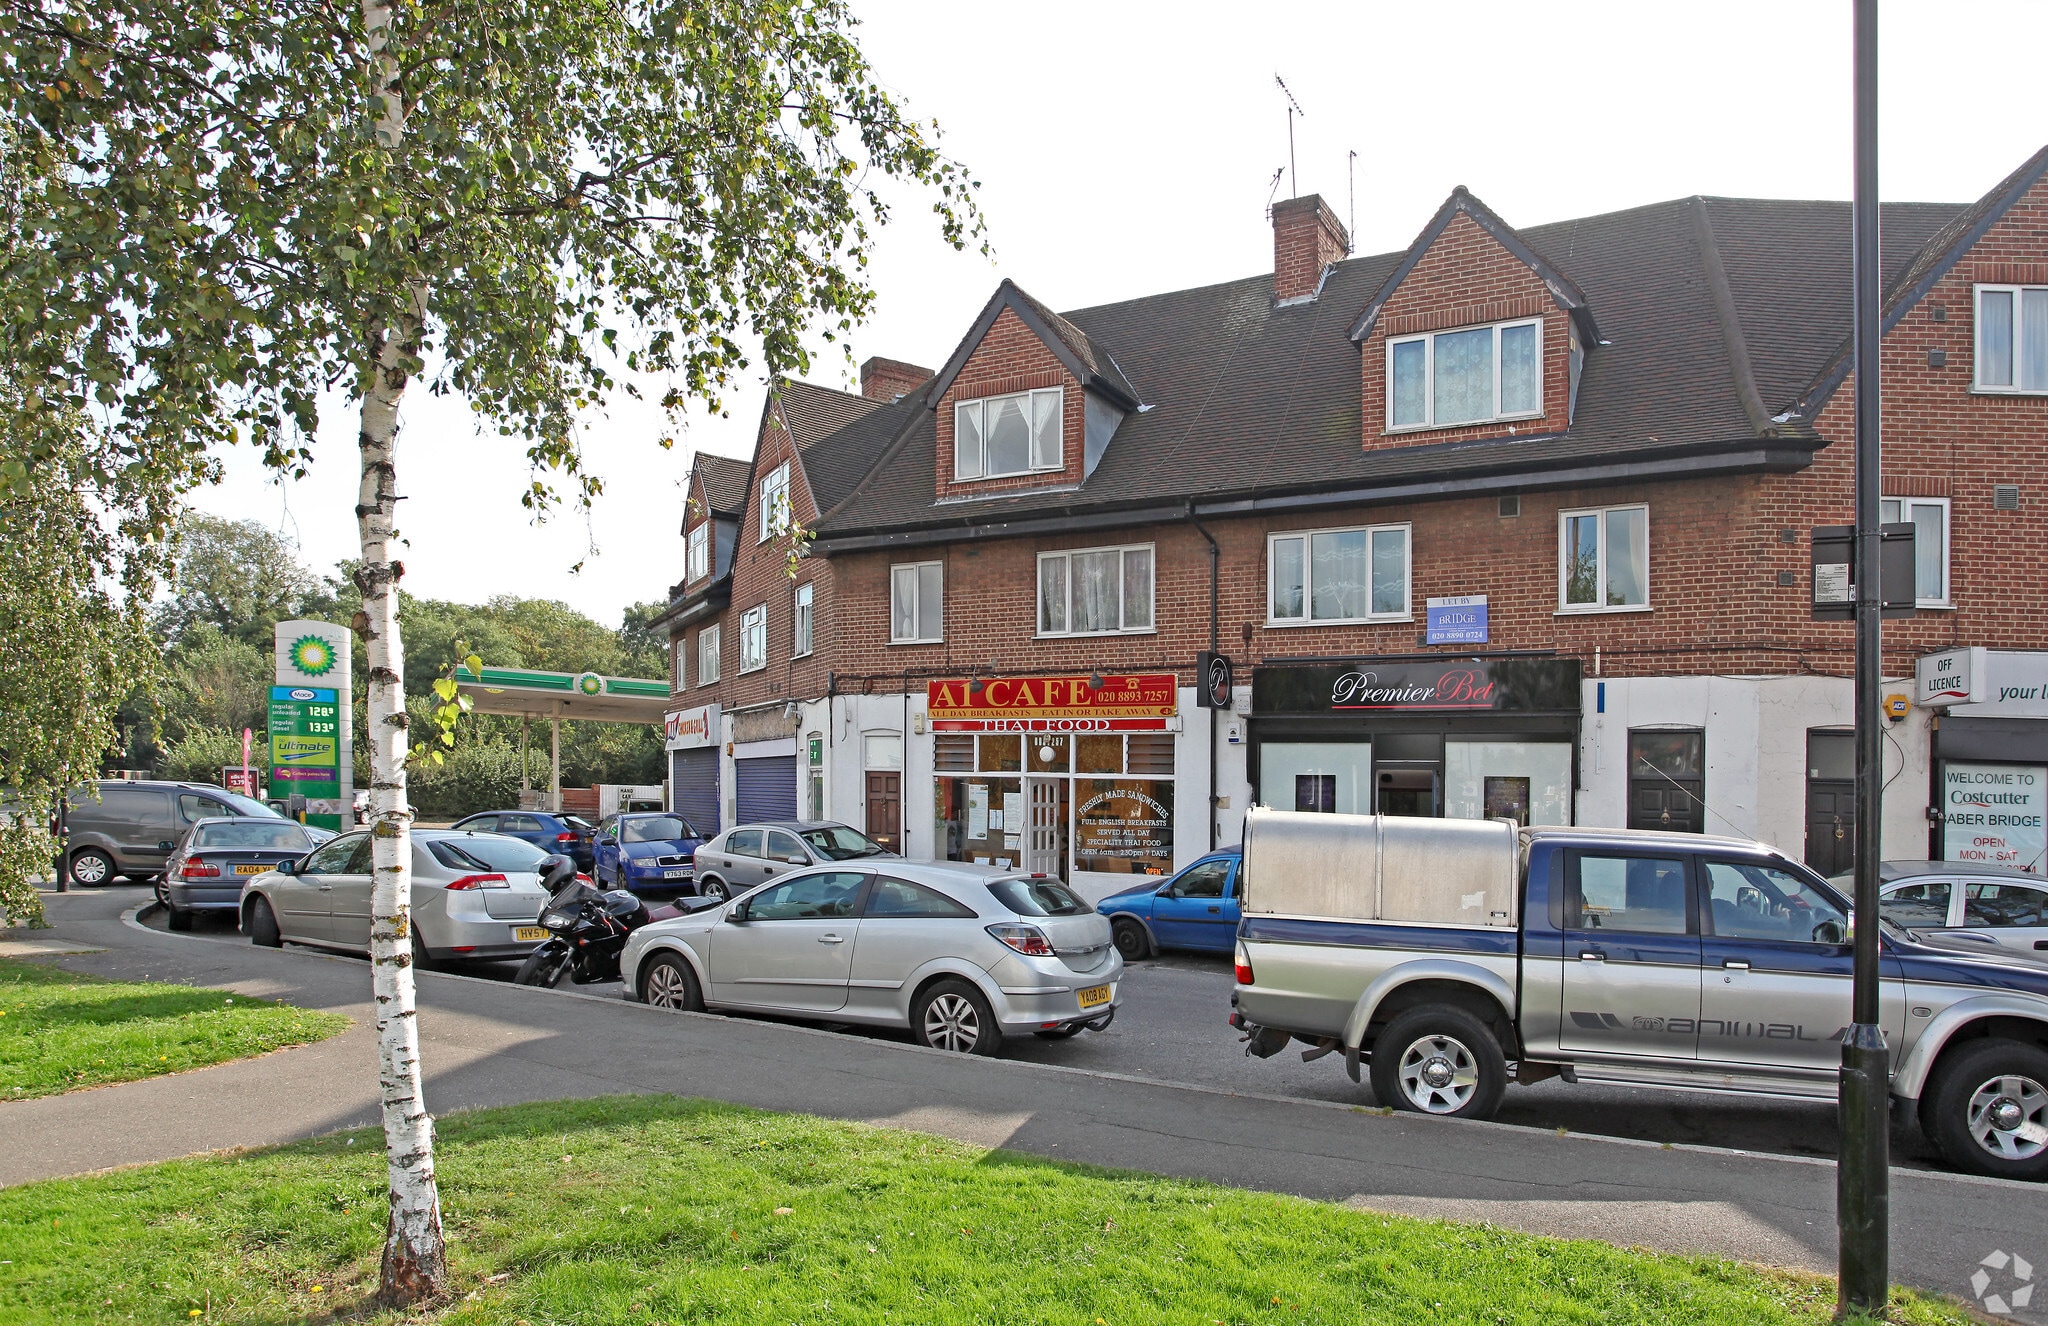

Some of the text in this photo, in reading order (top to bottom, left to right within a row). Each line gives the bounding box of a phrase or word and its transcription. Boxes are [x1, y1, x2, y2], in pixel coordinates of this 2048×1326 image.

[1439, 613, 1477, 625] BRIDGE
[1465, 631, 1483, 639] 0724
[1937, 658, 1953, 672] OFF
[1331, 669, 1495, 703] Premier Bet
[1928, 675, 1961, 691] LICENCE
[932, 679, 1092, 708] A1 CAFE
[1098, 690, 1168, 702] 020 8893 7257
[1998, 686, 2038, 702] your
[980, 719, 1110, 731] THAI FOOD
[278, 741, 331, 751] ultimate
[1947, 772, 2034, 785] WELCOME TO
[1951, 790, 2030, 805] Costcutter
[1078, 789, 1169, 820] FRESHLY MADE SANDWICHES
[1081, 818, 1167, 827] FULL ENGLISH BREAKFASTS
[1943, 813, 2042, 827] ABER BRIDGE
[1087, 838, 1122, 846] SPECIALITY
[1142, 839, 1162, 847] FOOD
[1973, 837, 2006, 848] OPEN
[1959, 850, 1986, 860] MON
[1996, 850, 2018, 861] SAT
[236, 866, 260, 874] RA04
[520, 928, 545, 939] HV57
[1081, 990, 1098, 1003] YA08
